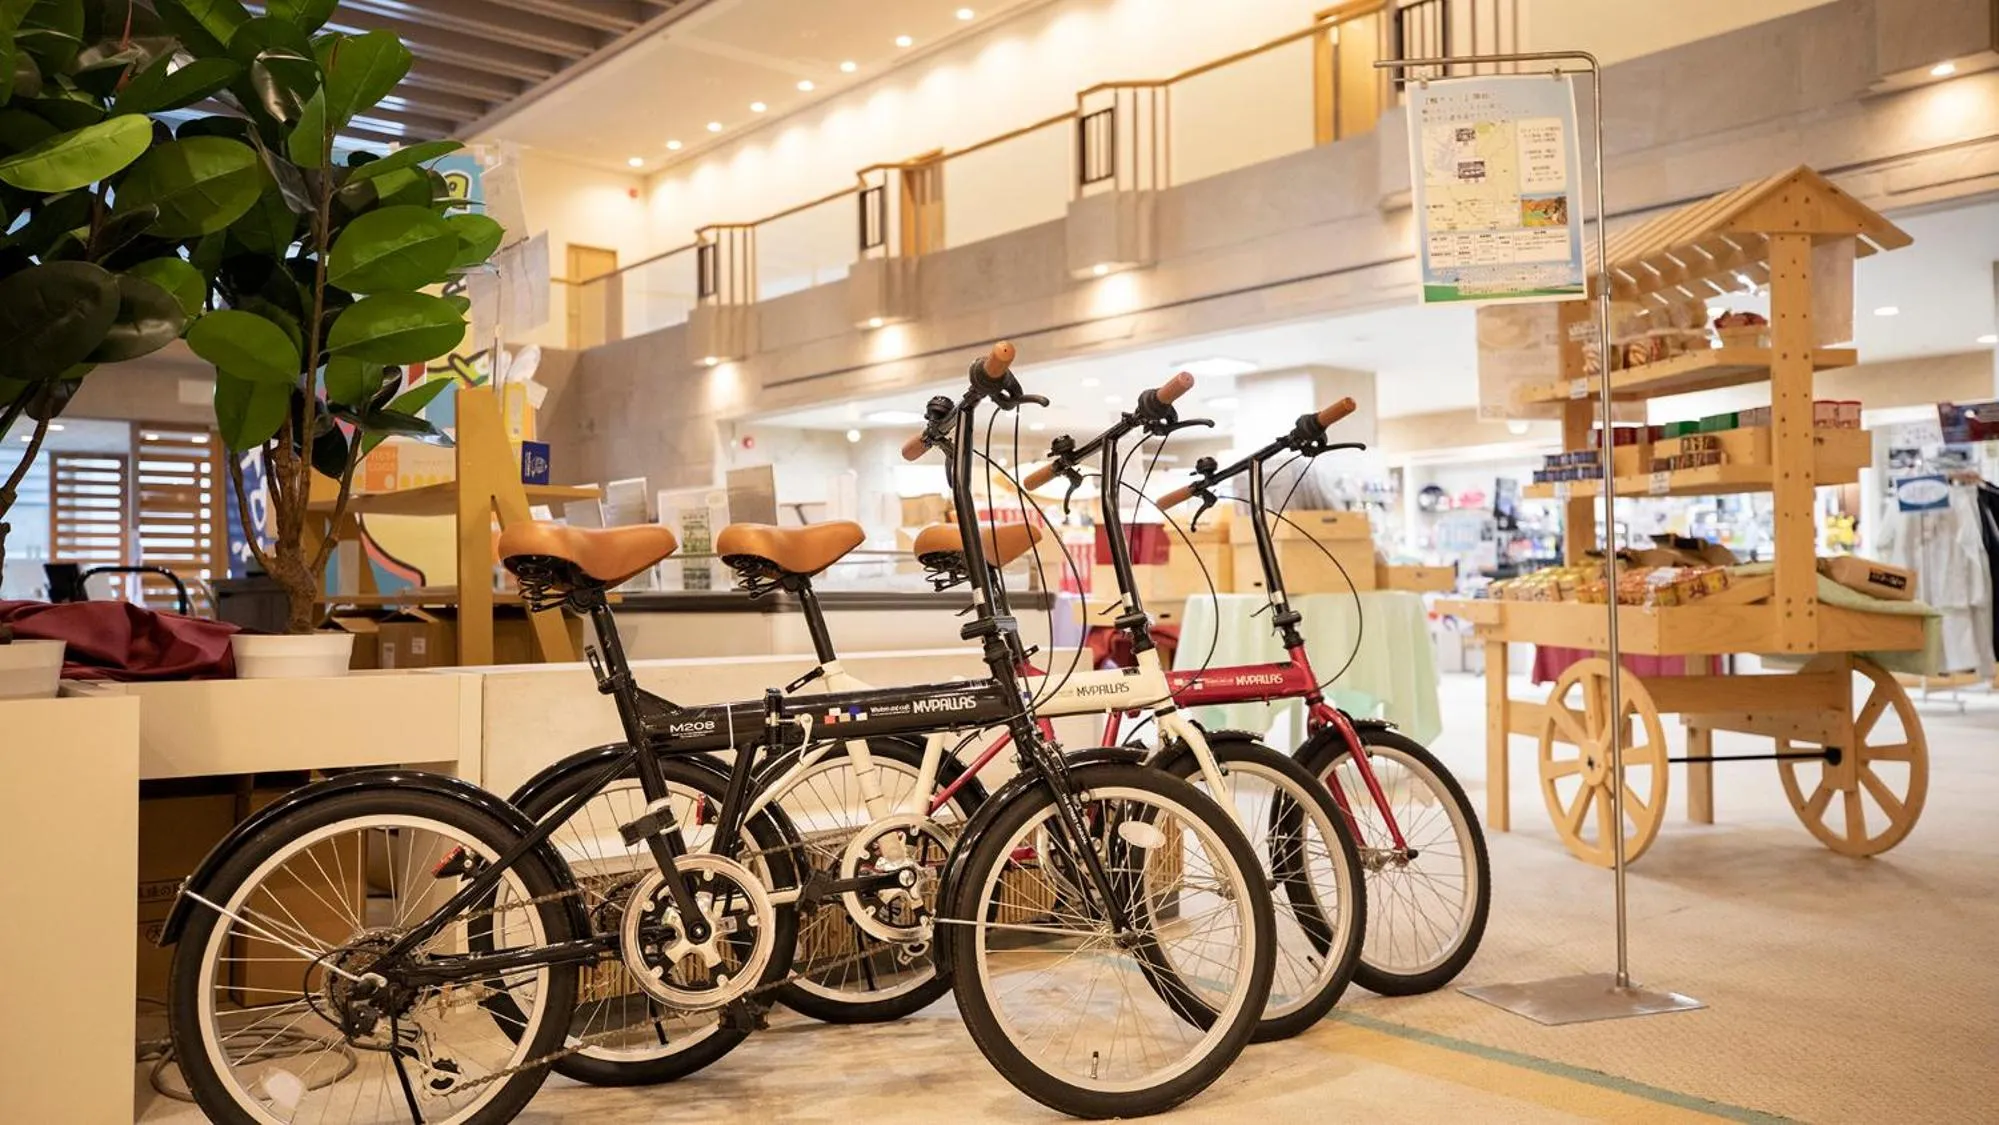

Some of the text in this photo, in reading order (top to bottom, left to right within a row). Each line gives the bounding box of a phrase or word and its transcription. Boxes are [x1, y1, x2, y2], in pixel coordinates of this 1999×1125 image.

[1235, 674, 1284, 686] MYPALLAS
[1076, 682, 1130, 697] MYPALLAS
[913, 695, 977, 714] MYPALLAS
[669, 720, 715, 733] M208
